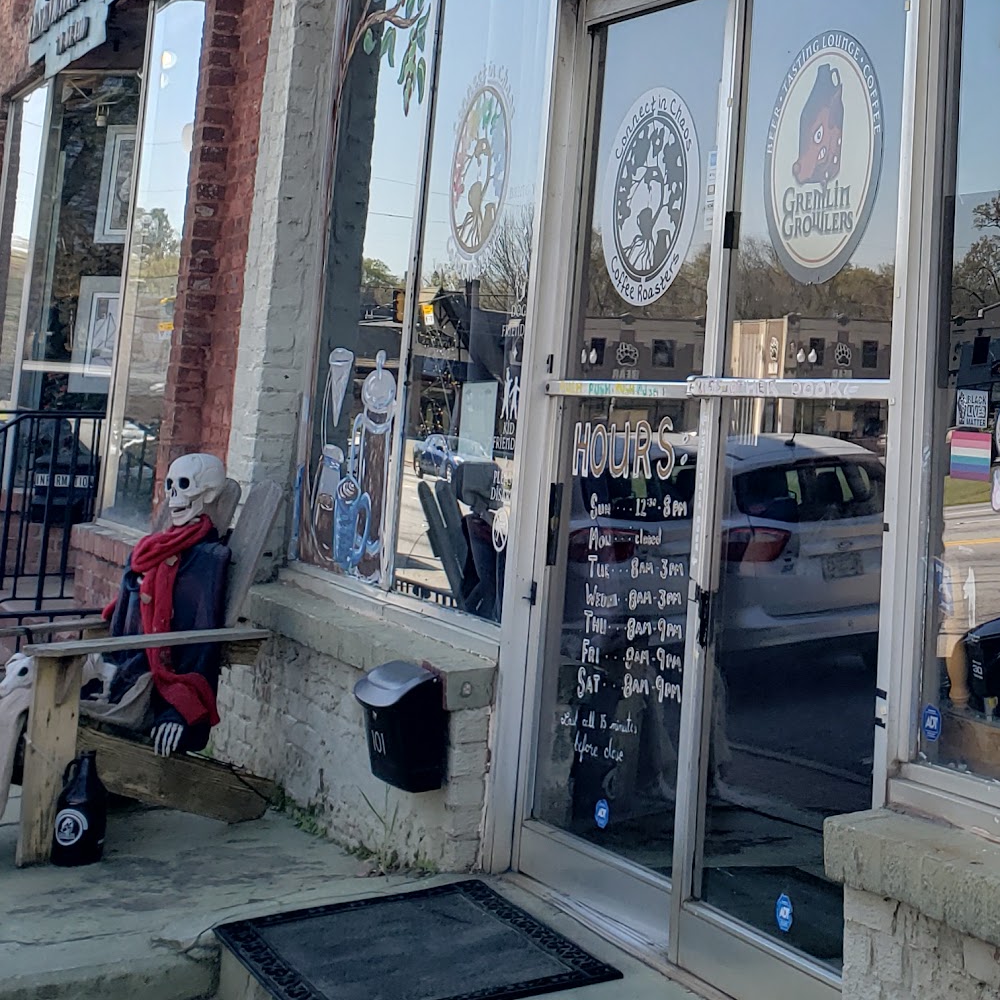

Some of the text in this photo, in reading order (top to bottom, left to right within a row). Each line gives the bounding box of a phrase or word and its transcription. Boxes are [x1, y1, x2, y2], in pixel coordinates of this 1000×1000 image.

[767, 106, 781, 154] BEER
[863, 64, 881, 136] COFFEE
[615, 95, 692, 160] Connect in Chaos
[611, 253, 680, 302] Coffee Roasters
[501, 324, 525, 338] FRIEND
[967, 394, 987, 405] BLACK
[966, 404, 987, 418] LIVES
[966, 417, 986, 427] MATTER
[493, 434, 516, 451] FRIEND
[371, 730, 386, 755] 101
